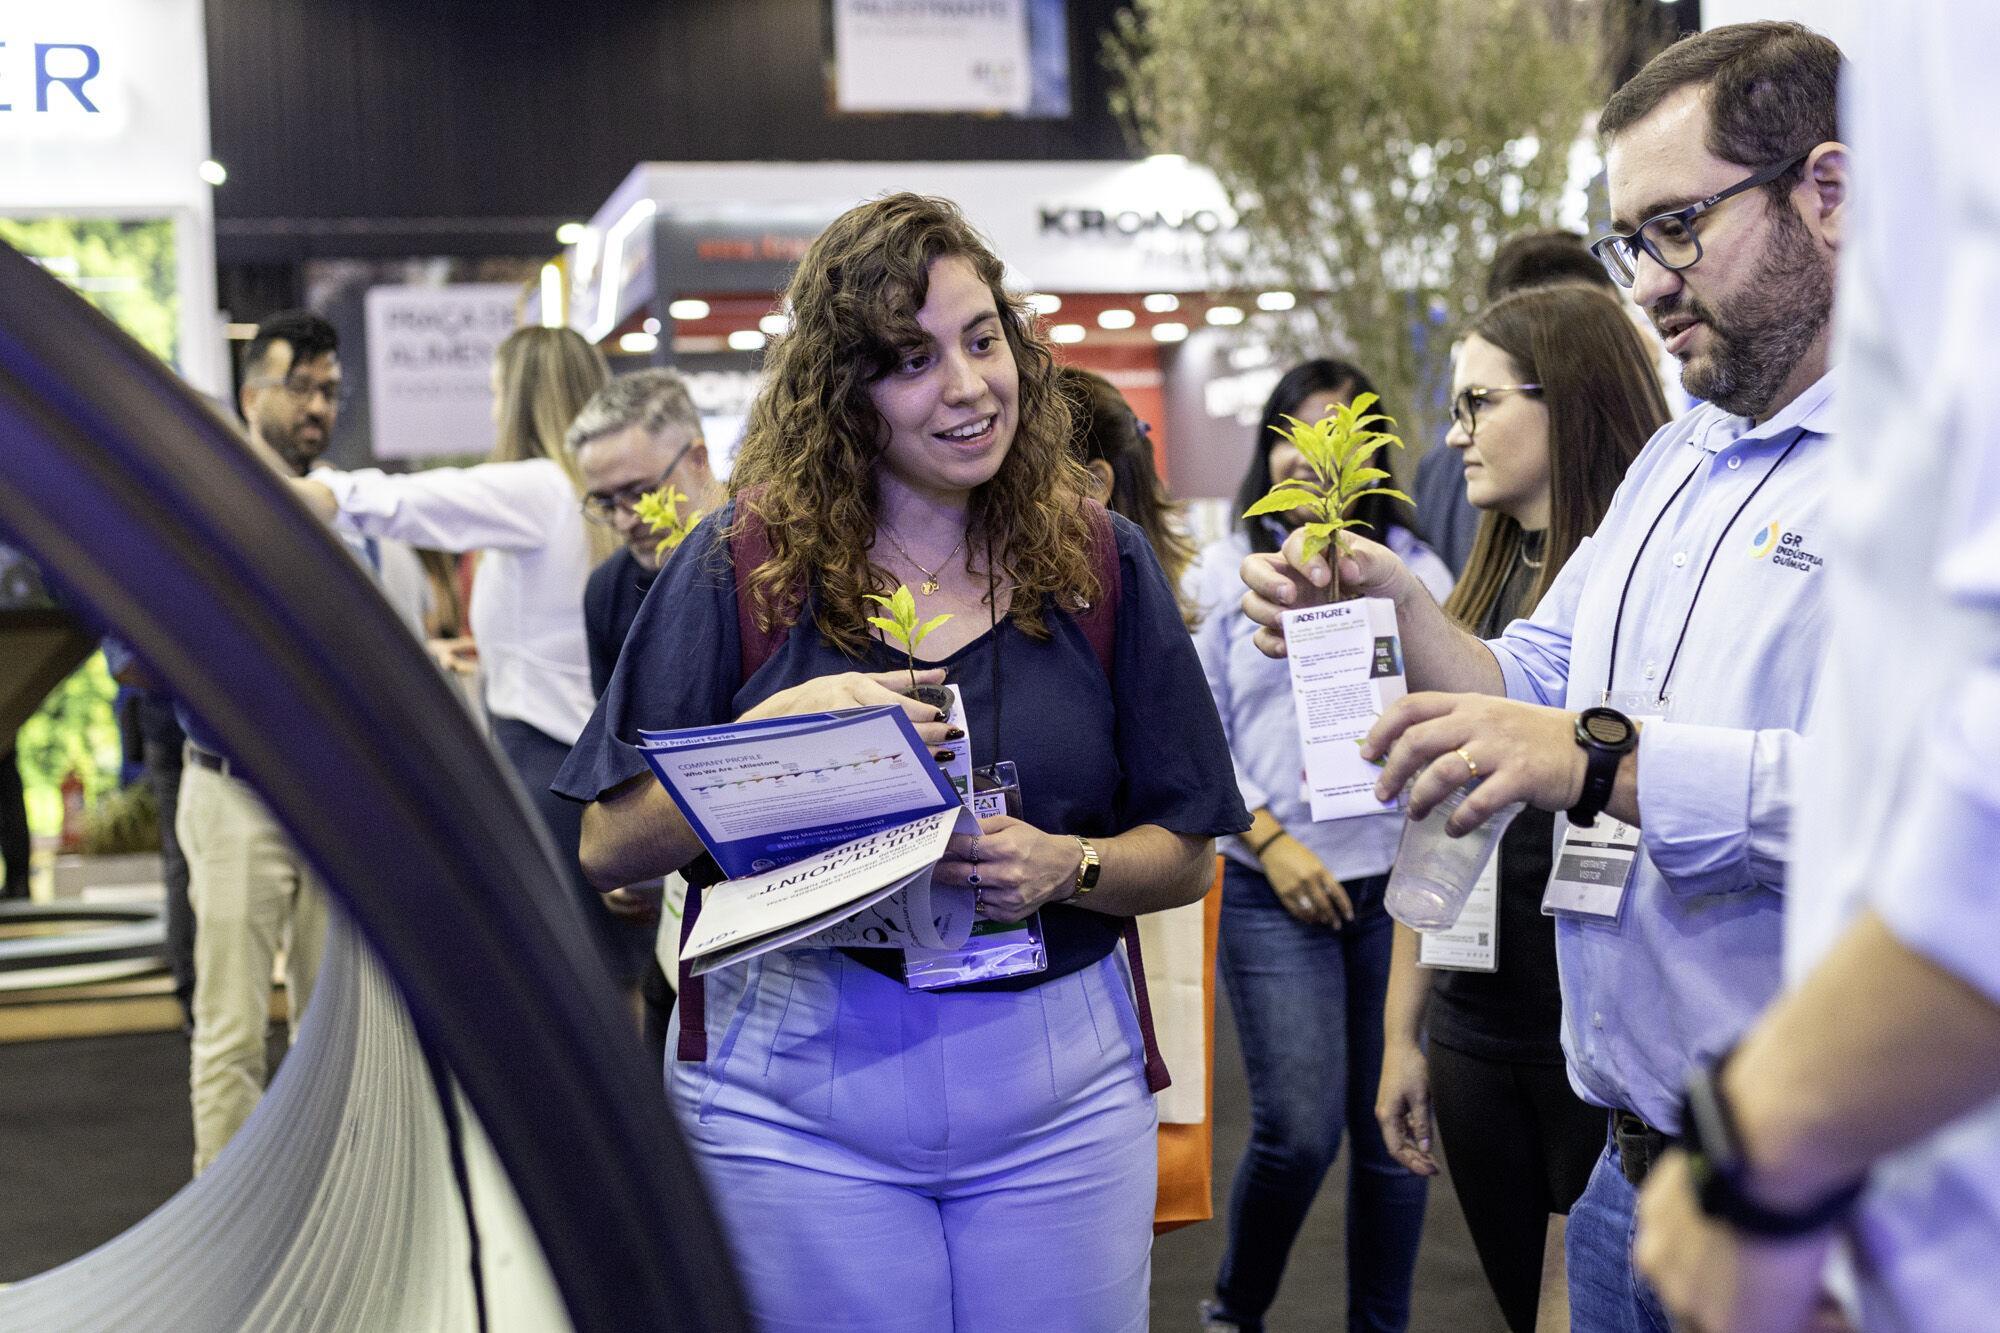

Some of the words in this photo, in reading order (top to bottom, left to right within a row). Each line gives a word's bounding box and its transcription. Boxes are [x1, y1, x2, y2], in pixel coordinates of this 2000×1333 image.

[1781, 532, 1803, 547] GR
[1772, 555, 1811, 572] QUÍMICA
[1776, 545, 1824, 566] INDÚSTRIA
[678, 759, 724, 771] COMPANY
[725, 754, 763, 764] PROFILE
[684, 770, 703, 778] Who
[740, 760, 780, 770] Milestone
[973, 796, 998, 812] FAT
[886, 812, 945, 839] 3000
[823, 837, 878, 861] Plus
